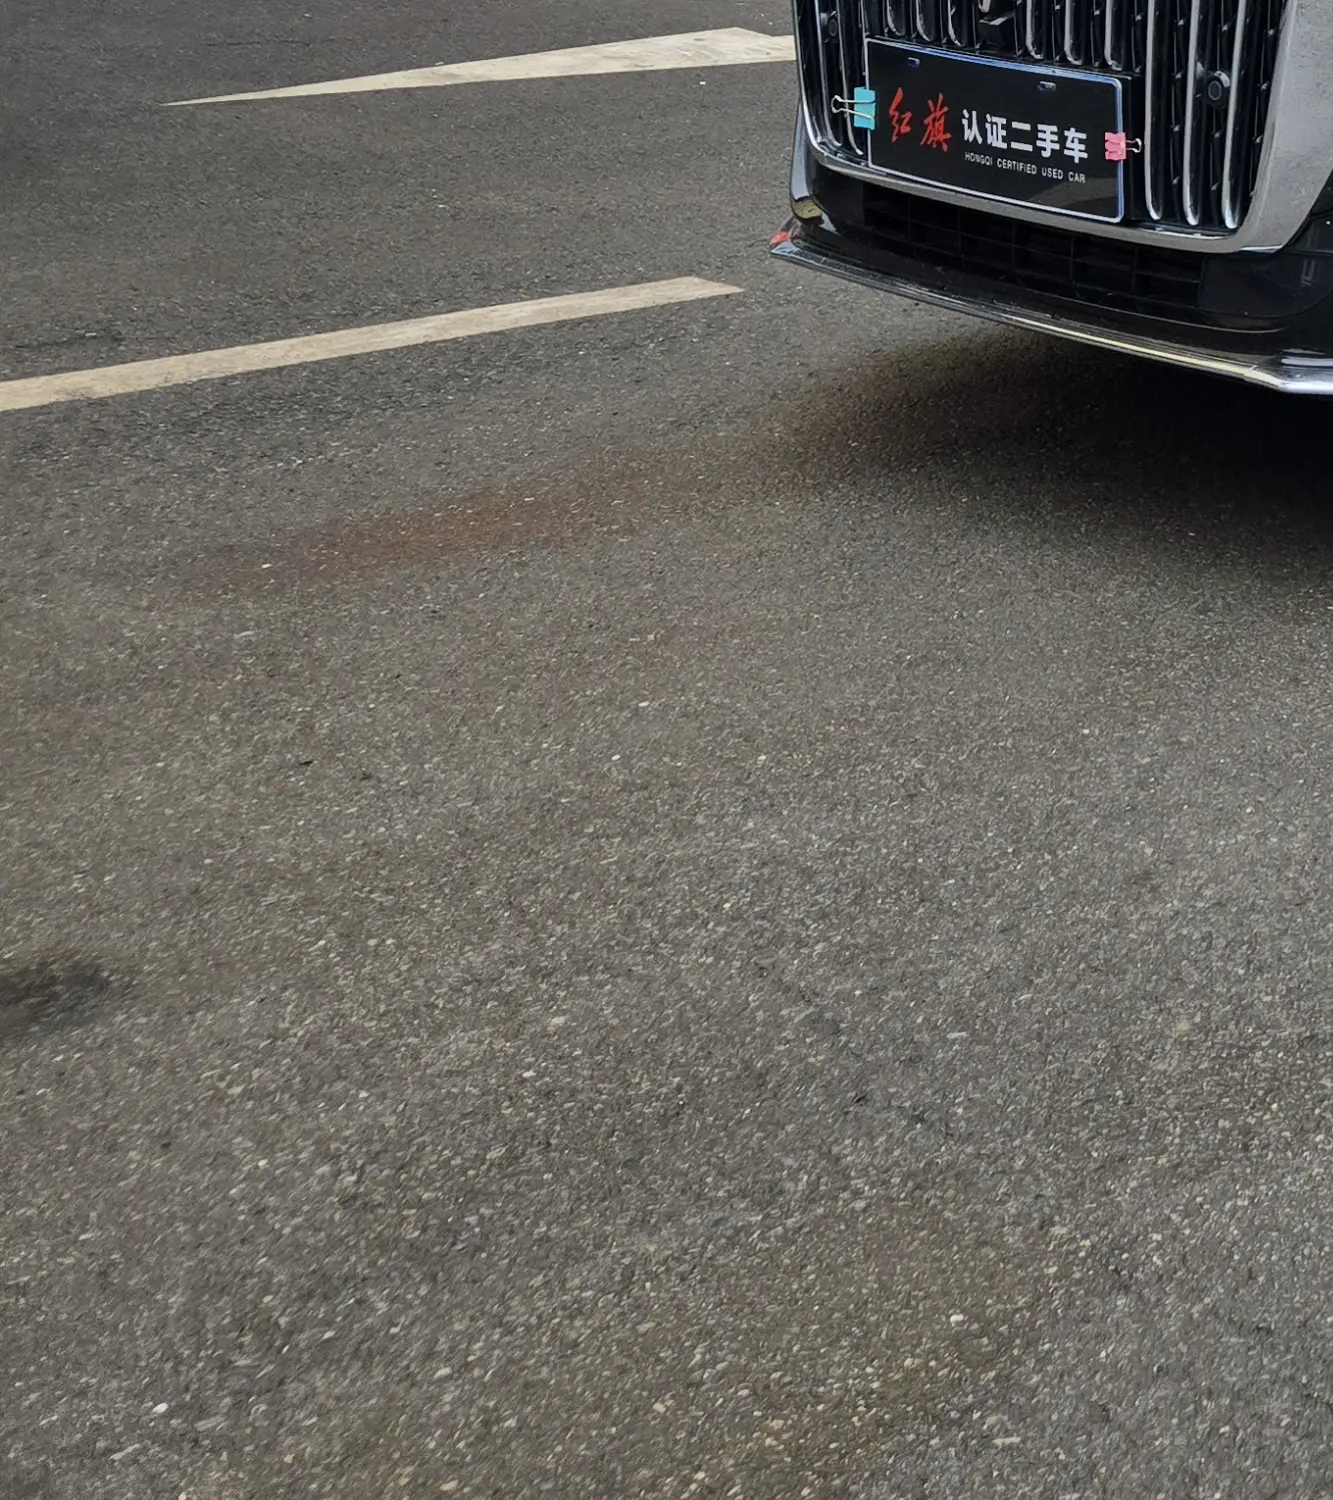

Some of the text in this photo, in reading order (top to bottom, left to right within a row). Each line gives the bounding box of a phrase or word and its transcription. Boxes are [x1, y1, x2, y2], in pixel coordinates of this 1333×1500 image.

[888, 87, 1088, 163] 红旗 认证二手车
[964, 151, 1086, 184] HONGQI CERTIFIED USED CAR
